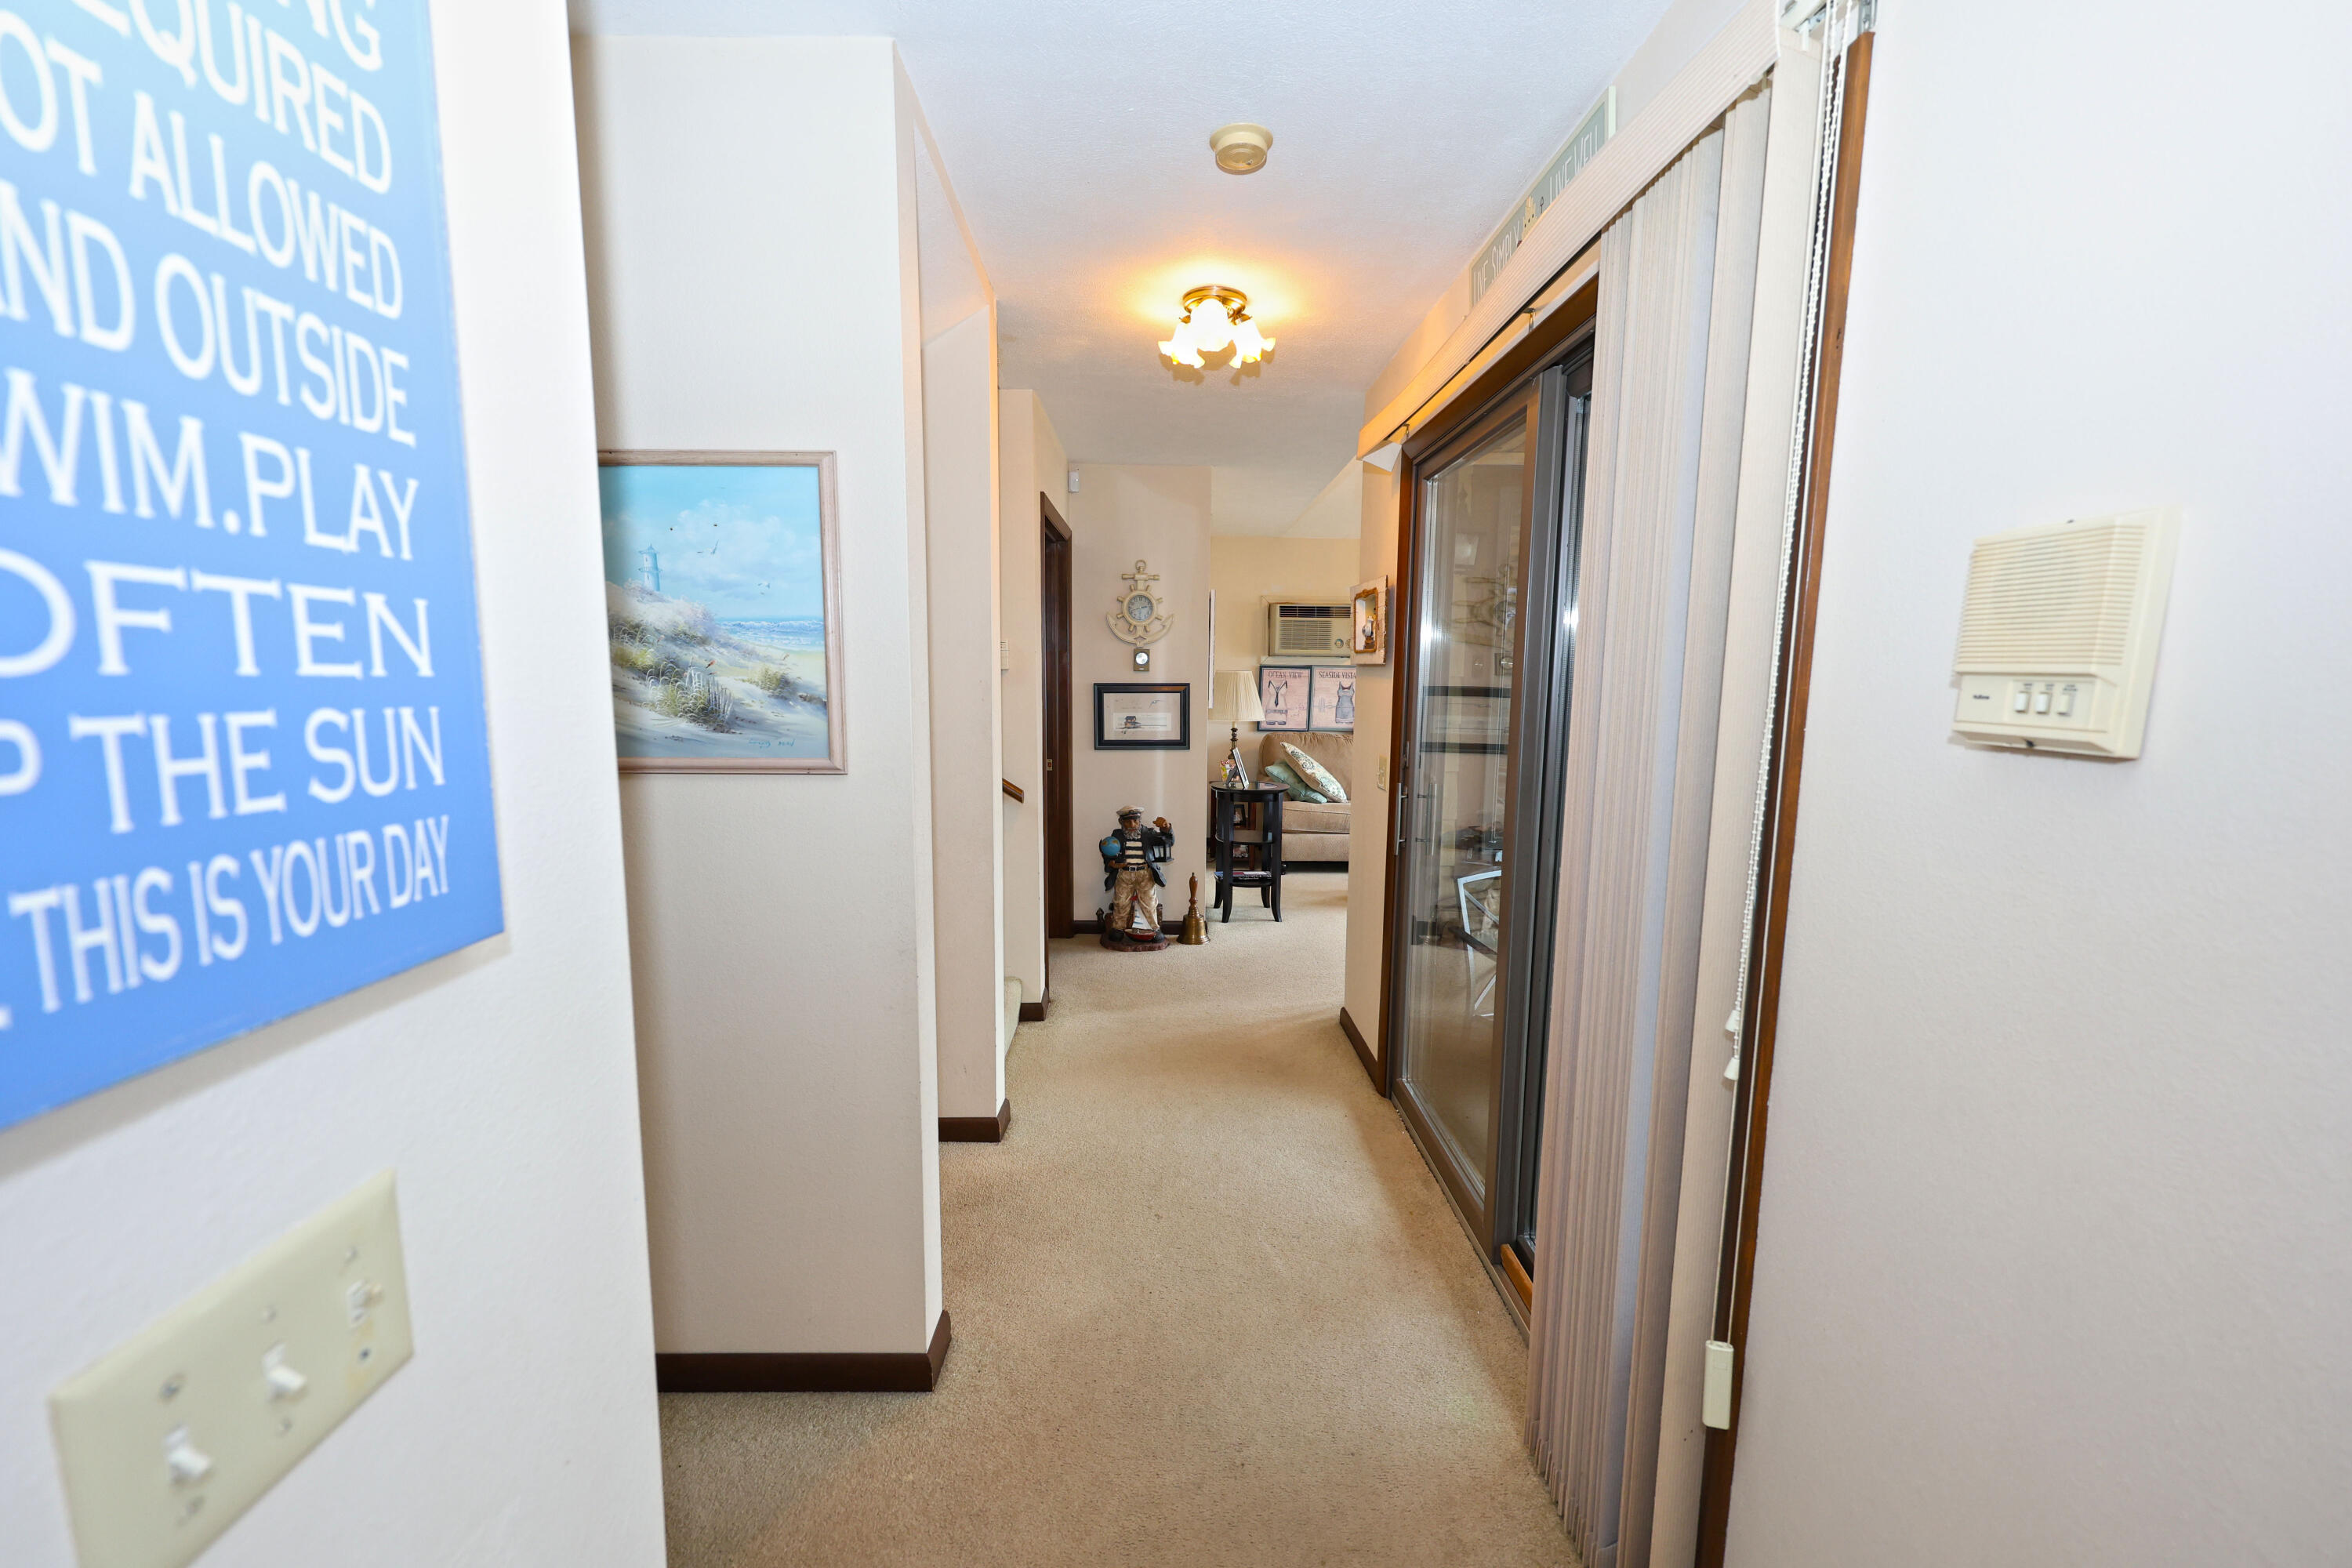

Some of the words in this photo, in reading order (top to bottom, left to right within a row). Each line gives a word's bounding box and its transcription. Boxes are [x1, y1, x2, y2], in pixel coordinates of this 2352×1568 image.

[71, 0, 392, 194] QUIRED
[129, 90, 403, 319] ALLOWED
[0, 177, 136, 351] ND
[154, 253, 416, 448] OUTSIDE
[68, 709, 286, 834] THE
[304, 706, 446, 803] SUN
[9, 866, 183, 1014] THIS
[187, 854, 249, 967] IS
[249, 829, 381, 946] YOUR
[382, 814, 449, 910] DAY
